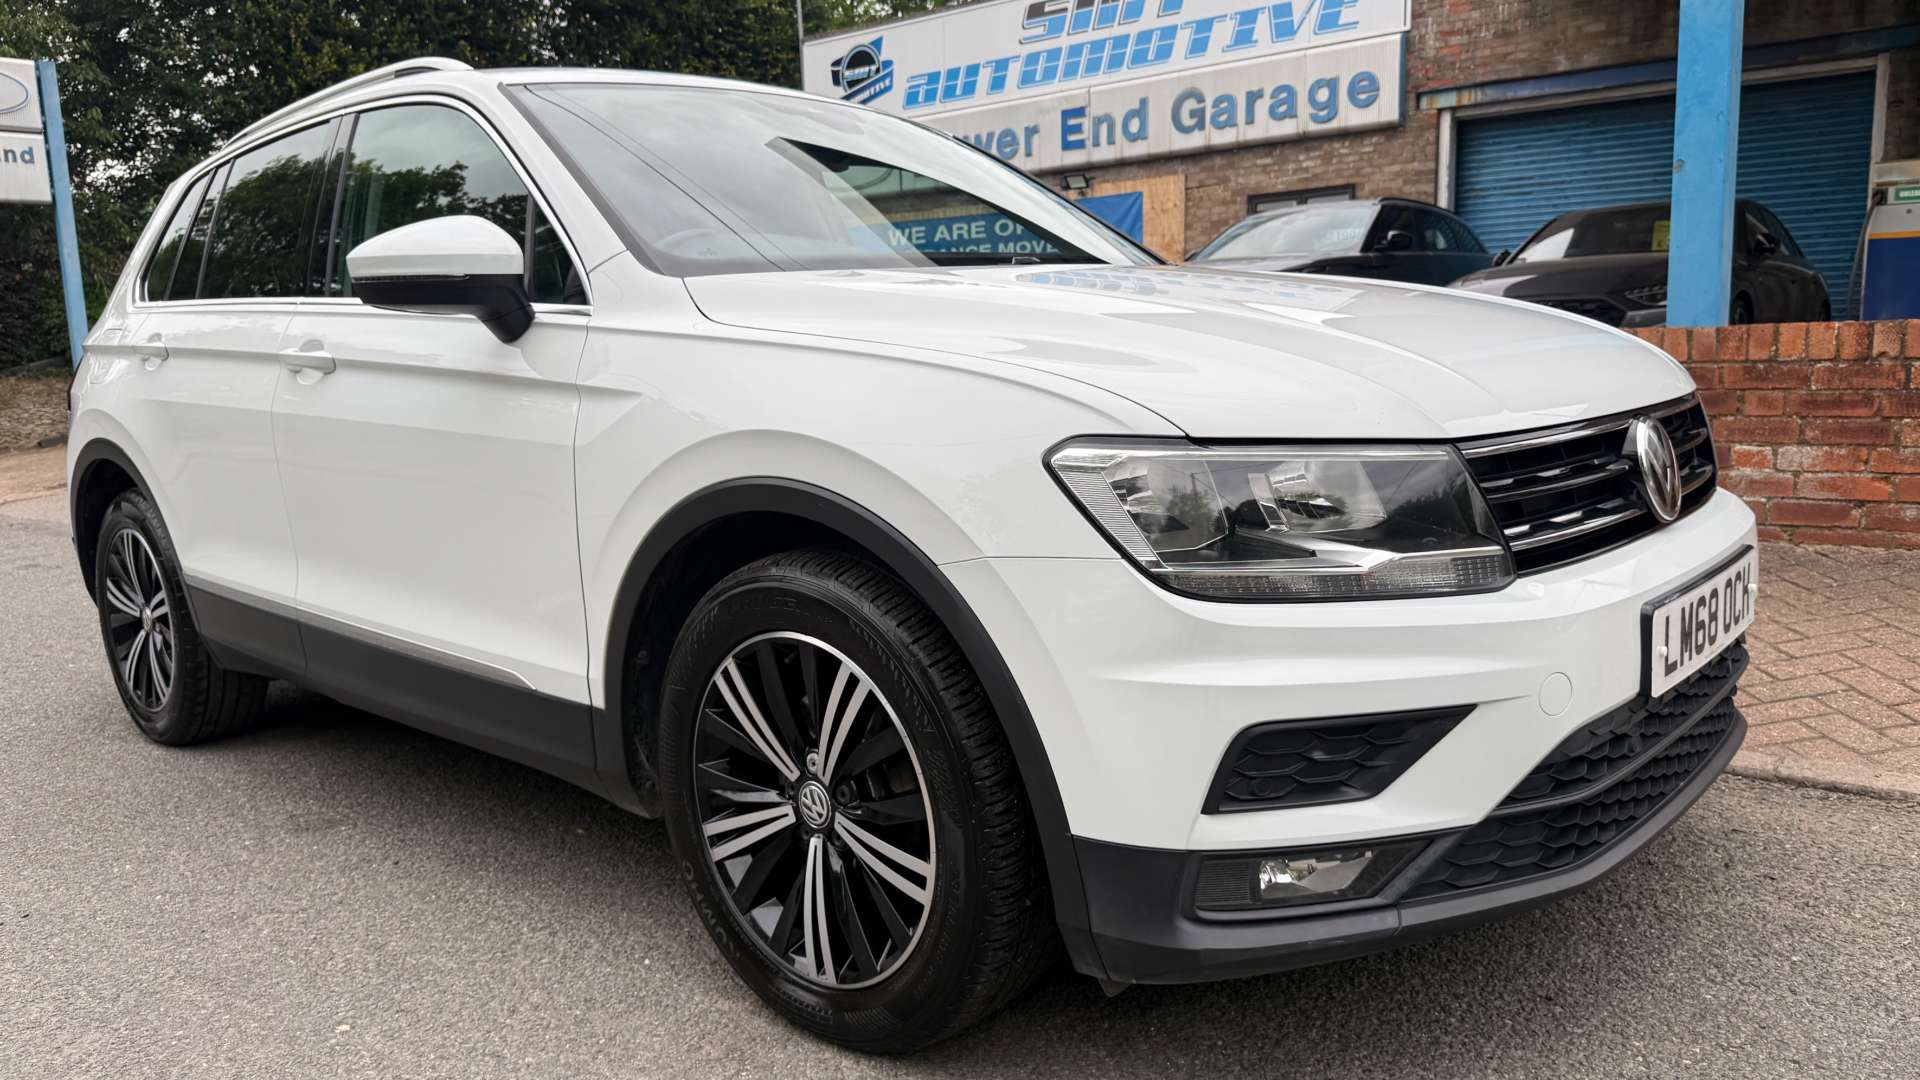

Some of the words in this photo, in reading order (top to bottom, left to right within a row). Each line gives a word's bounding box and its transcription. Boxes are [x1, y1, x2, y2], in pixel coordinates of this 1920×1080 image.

[962, 123, 1040, 160] wer
[1060, 96, 1149, 151] End
[1171, 71, 1380, 134] Garage
[0, 146, 35, 164] nd
[888, 226, 927, 246] WE
[933, 221, 986, 242] ARE
[1664, 587, 1719, 677] LM68
[1723, 562, 1750, 634] OCH
